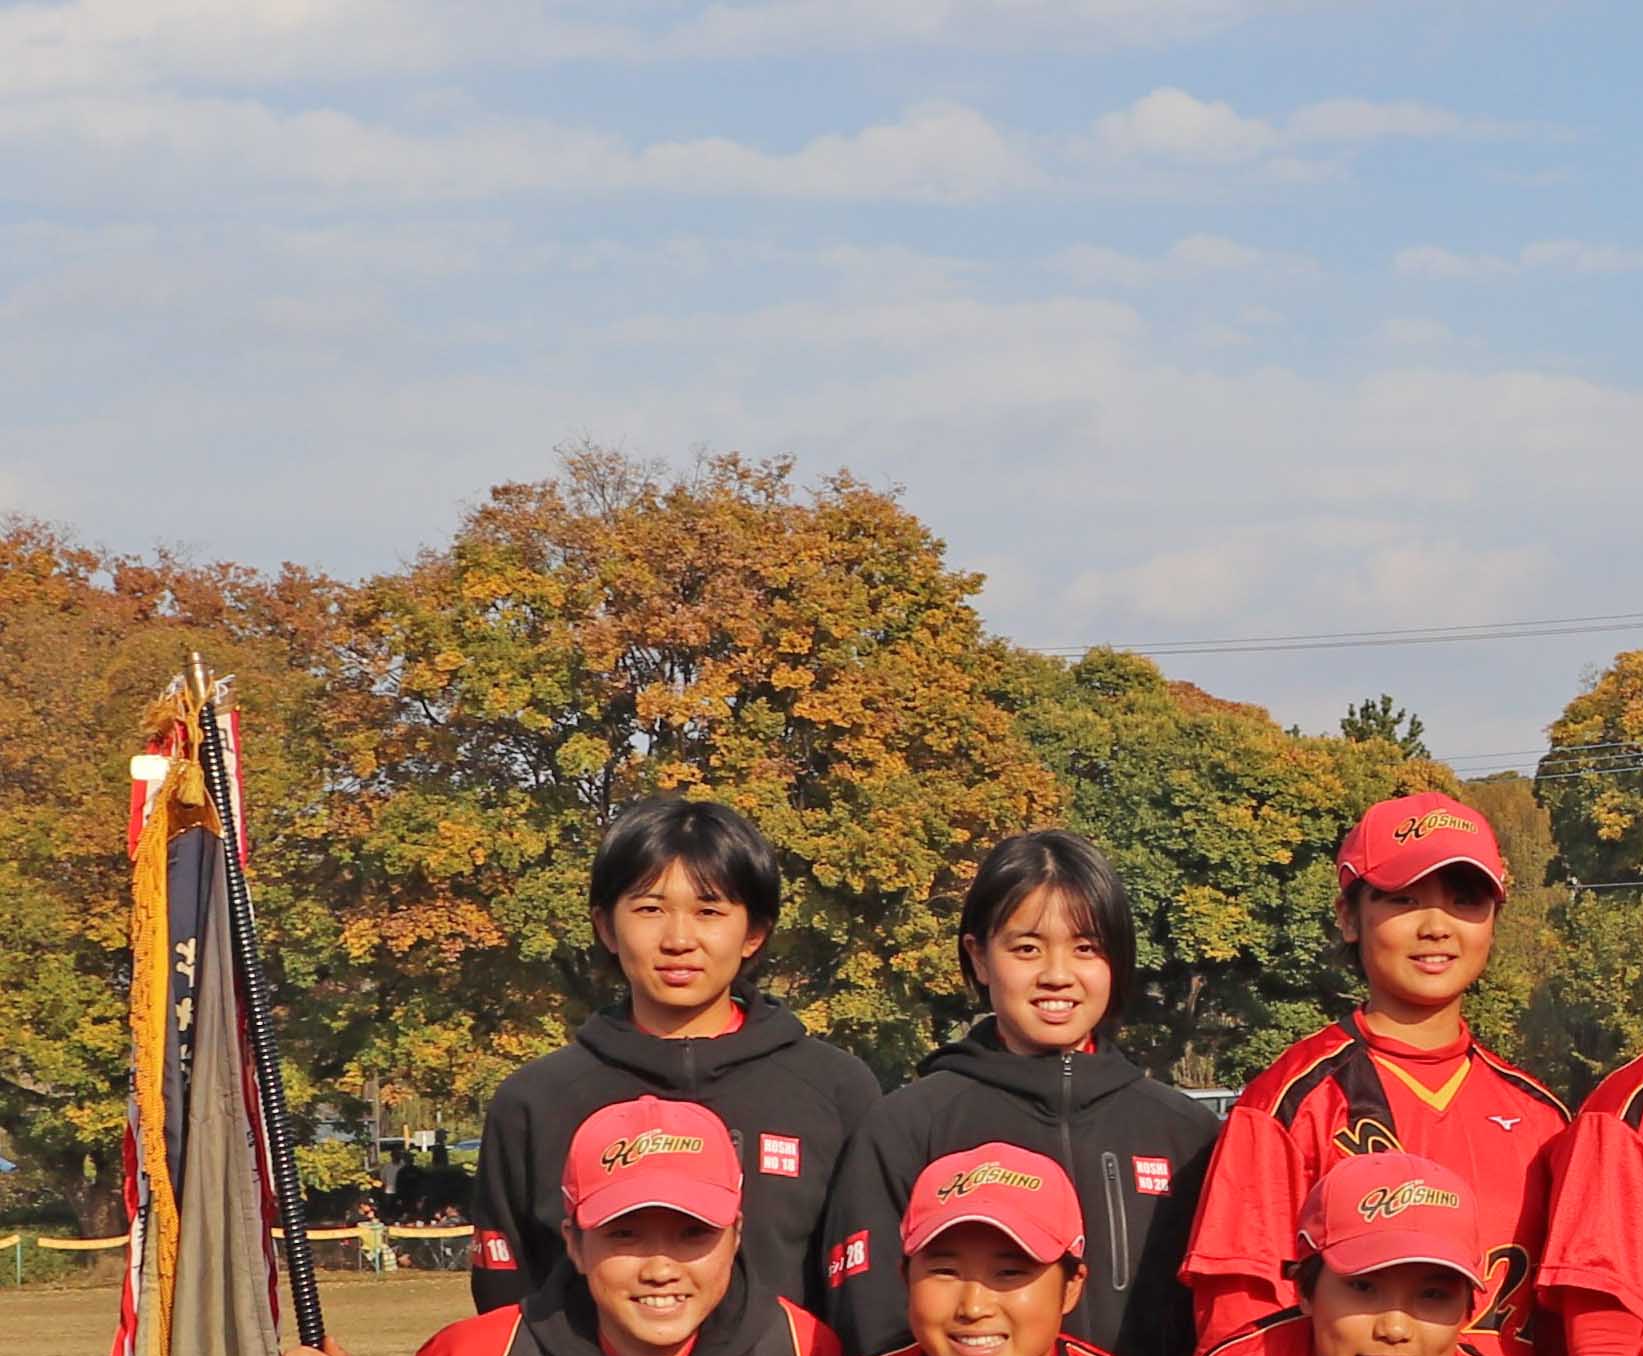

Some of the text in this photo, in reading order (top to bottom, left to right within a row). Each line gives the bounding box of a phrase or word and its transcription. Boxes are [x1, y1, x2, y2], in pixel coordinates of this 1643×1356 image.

[1393, 808, 1479, 846] HOSHINO
[601, 1128, 704, 1175] HOSHINO
[937, 1160, 1042, 1206] HOSHINO
[1357, 1178, 1460, 1223] HOSHINO
[486, 1238, 510, 1262] 18
[846, 1239, 865, 1269] 28
